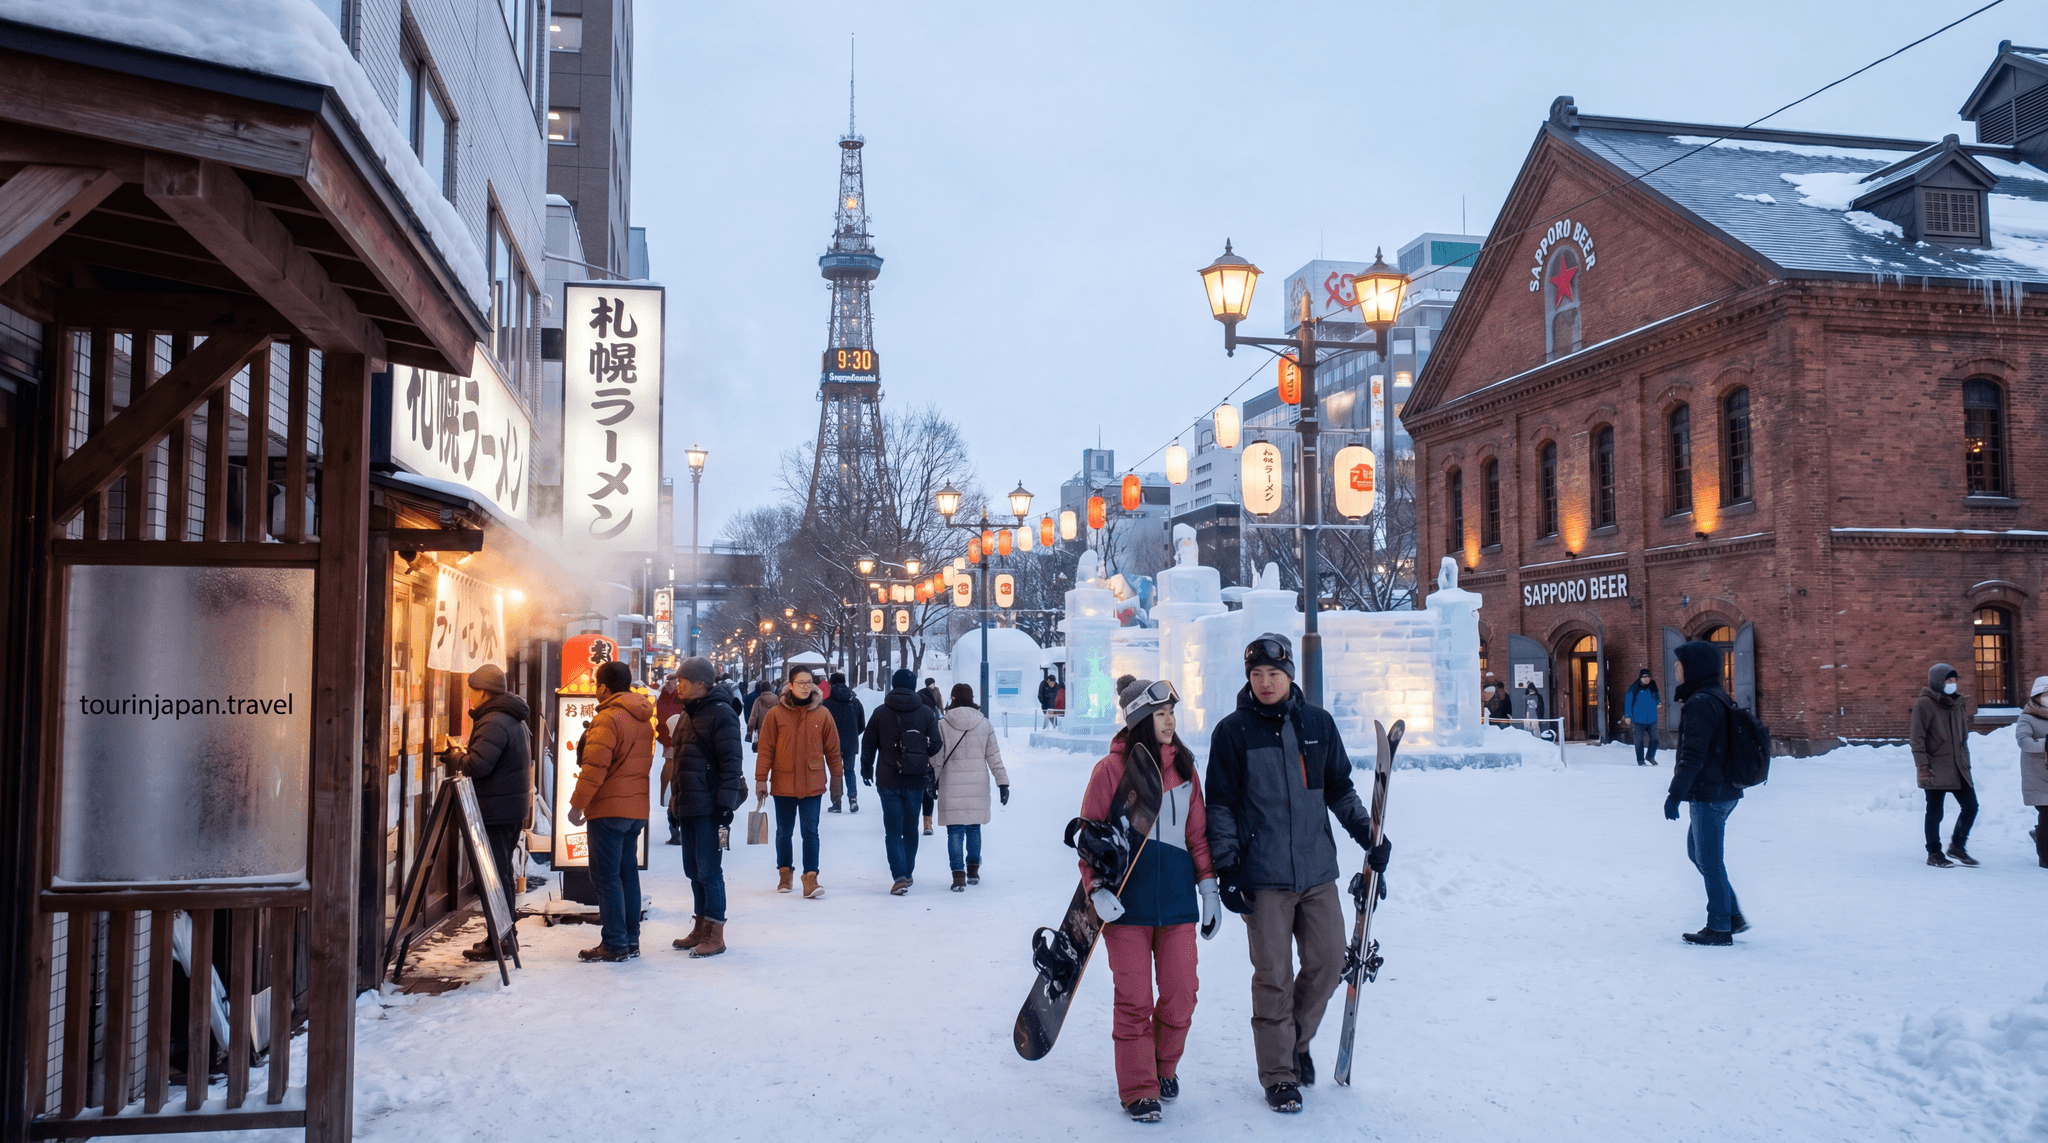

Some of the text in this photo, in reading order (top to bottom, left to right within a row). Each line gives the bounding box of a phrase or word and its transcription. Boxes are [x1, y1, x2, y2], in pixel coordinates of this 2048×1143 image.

[1529, 218, 1597, 292] SAPPORO BEER
[837, 349, 872, 370] 9:30
[406, 366, 524, 512] 札幌ラーメン
[587, 296, 639, 541] 札幌ラーメン
[1523, 573, 1628, 606] SAPPORO BEER
